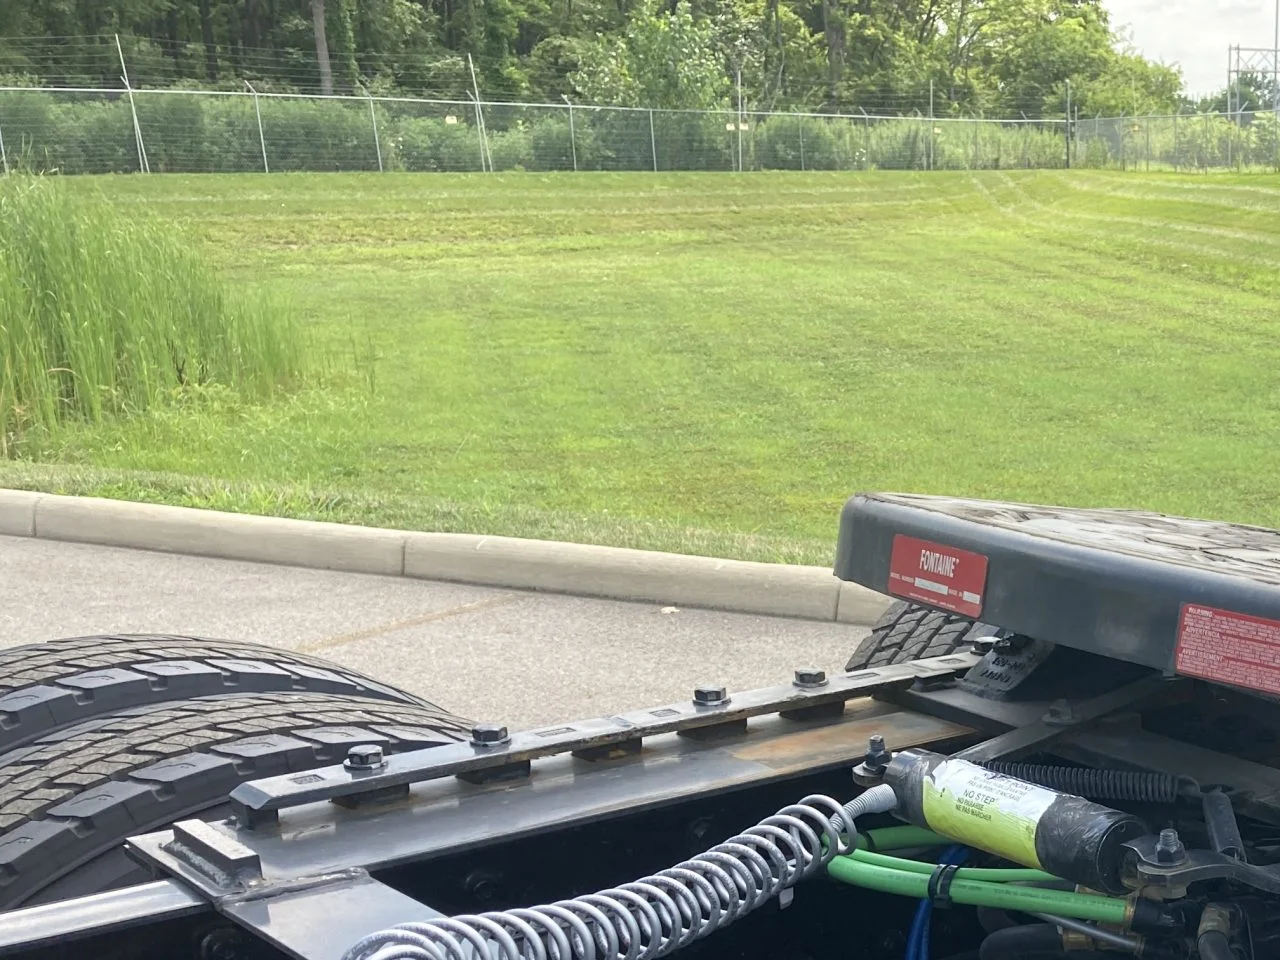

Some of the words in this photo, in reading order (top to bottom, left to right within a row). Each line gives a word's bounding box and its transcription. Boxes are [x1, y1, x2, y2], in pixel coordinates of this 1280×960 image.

[919, 549, 957, 578] FONTAINE
[963, 789, 975, 799] NO
[975, 793, 996, 805] STEP
